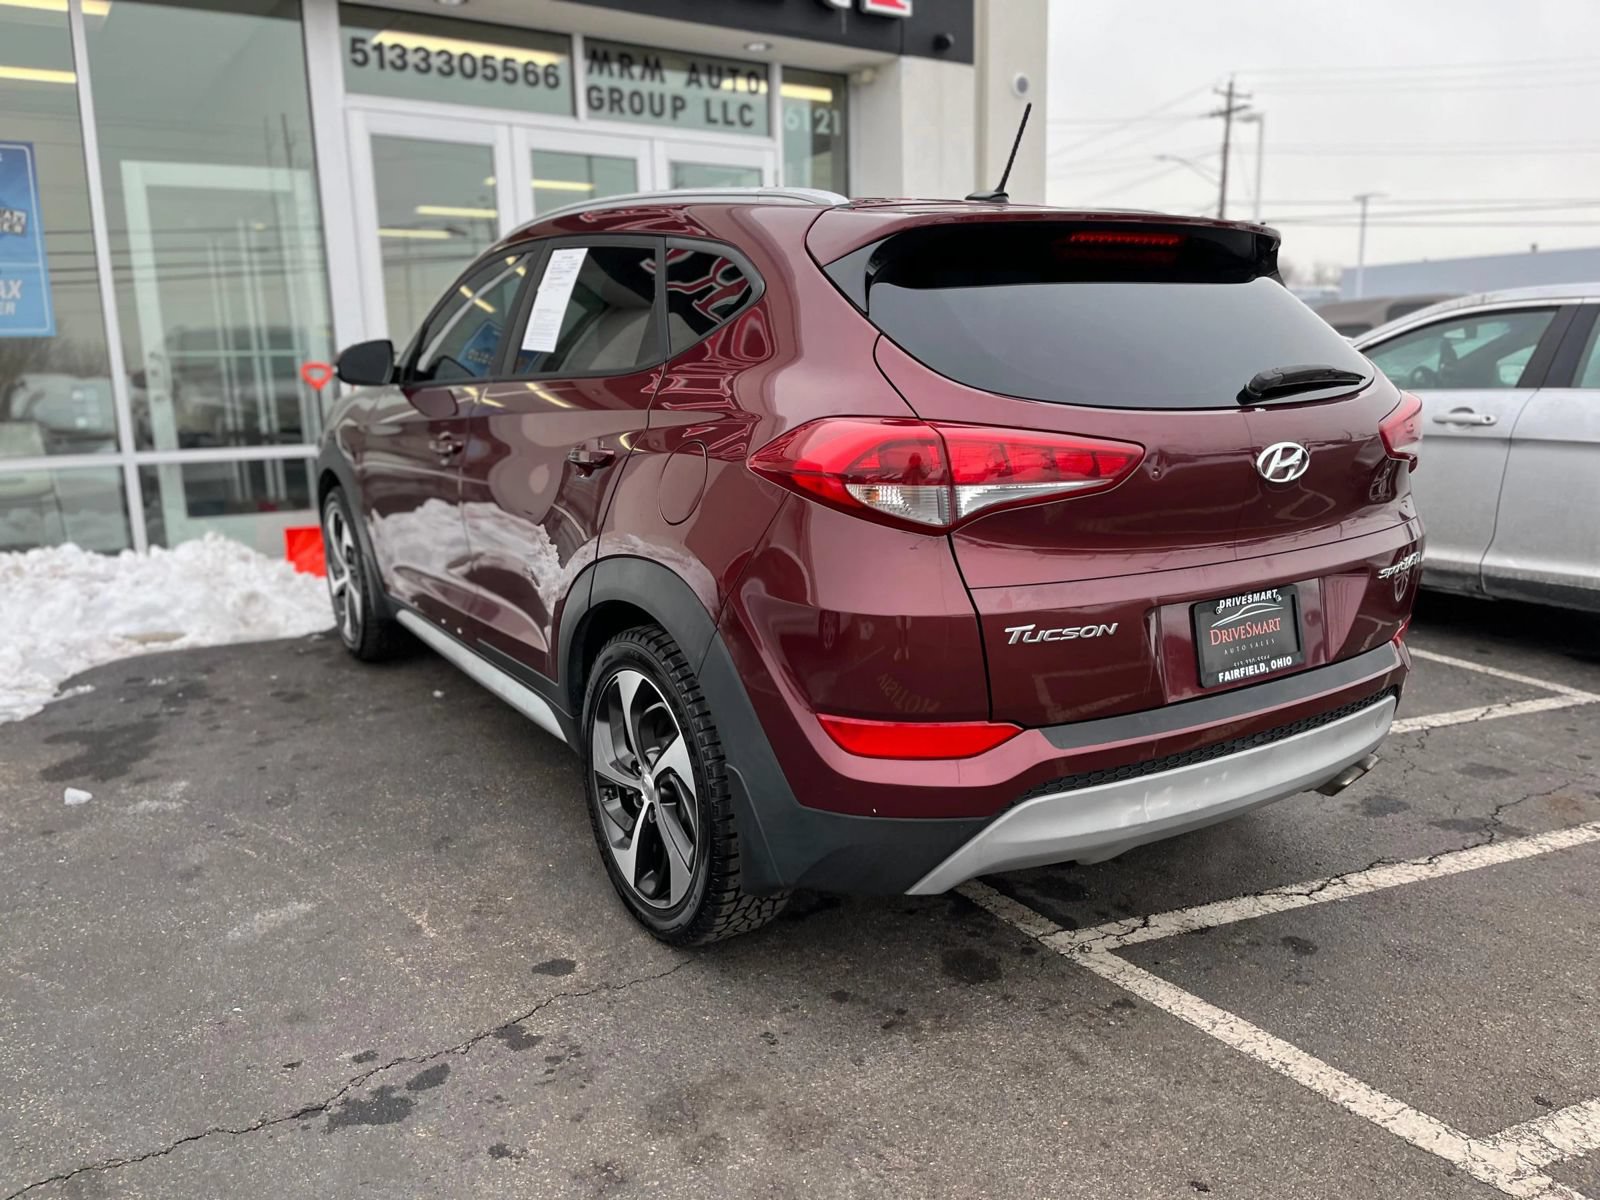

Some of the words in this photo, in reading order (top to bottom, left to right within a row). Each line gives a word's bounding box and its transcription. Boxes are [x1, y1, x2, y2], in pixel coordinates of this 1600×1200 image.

[351, 37, 560, 89] 5133305566
[587, 49, 667, 84] MRM
[685, 62, 761, 95] AUTO
[586, 85, 687, 121] GROUP
[704, 98, 755, 128] LLC
[783, 104, 842, 138] 6121
[1219, 589, 1278, 608] DRIVESMART
[1224, 645, 1247, 655] AUTO
[1250, 638, 1275, 649] SALES
[1218, 662, 1269, 683] FAIRFIELD,
[1271, 656, 1293, 669] OHIO
